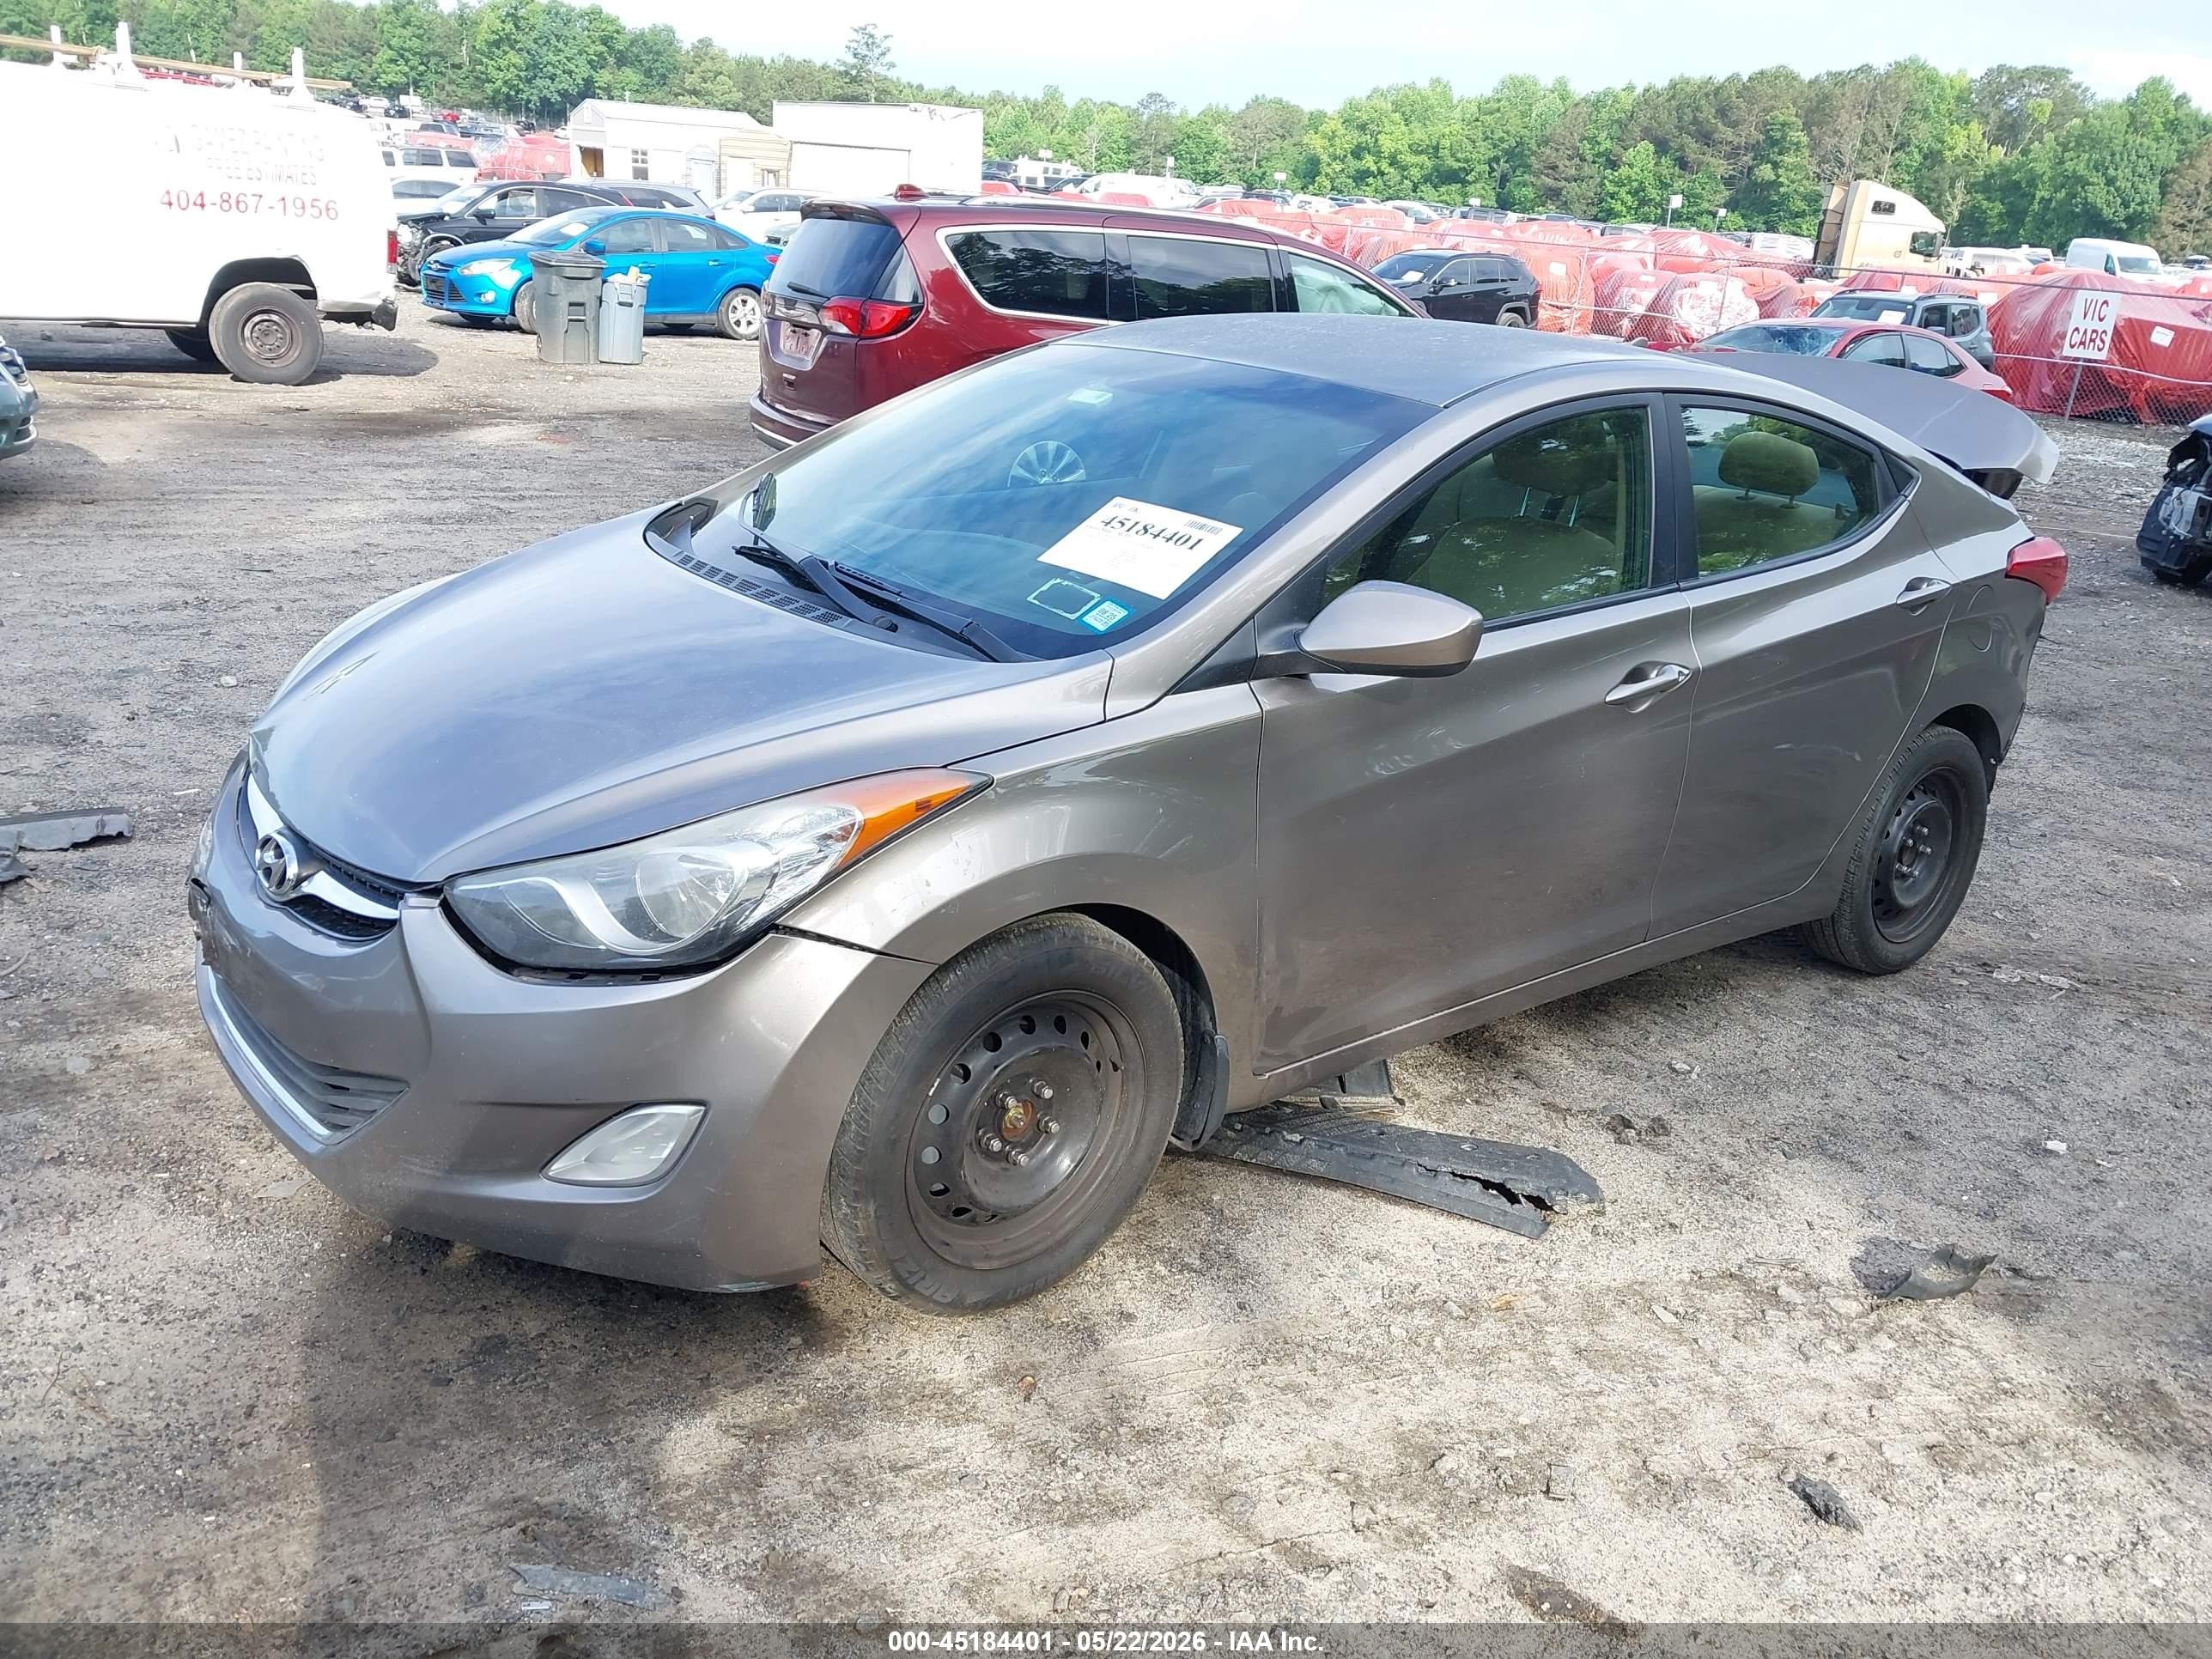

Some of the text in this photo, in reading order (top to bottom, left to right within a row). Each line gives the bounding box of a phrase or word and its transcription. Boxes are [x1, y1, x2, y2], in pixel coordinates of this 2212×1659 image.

[160, 189, 338, 221] 404-867-1956
[2082, 297, 2110, 323] VIC
[2069, 325, 2108, 352] CARS
[1100, 514, 1205, 551] 45184401
